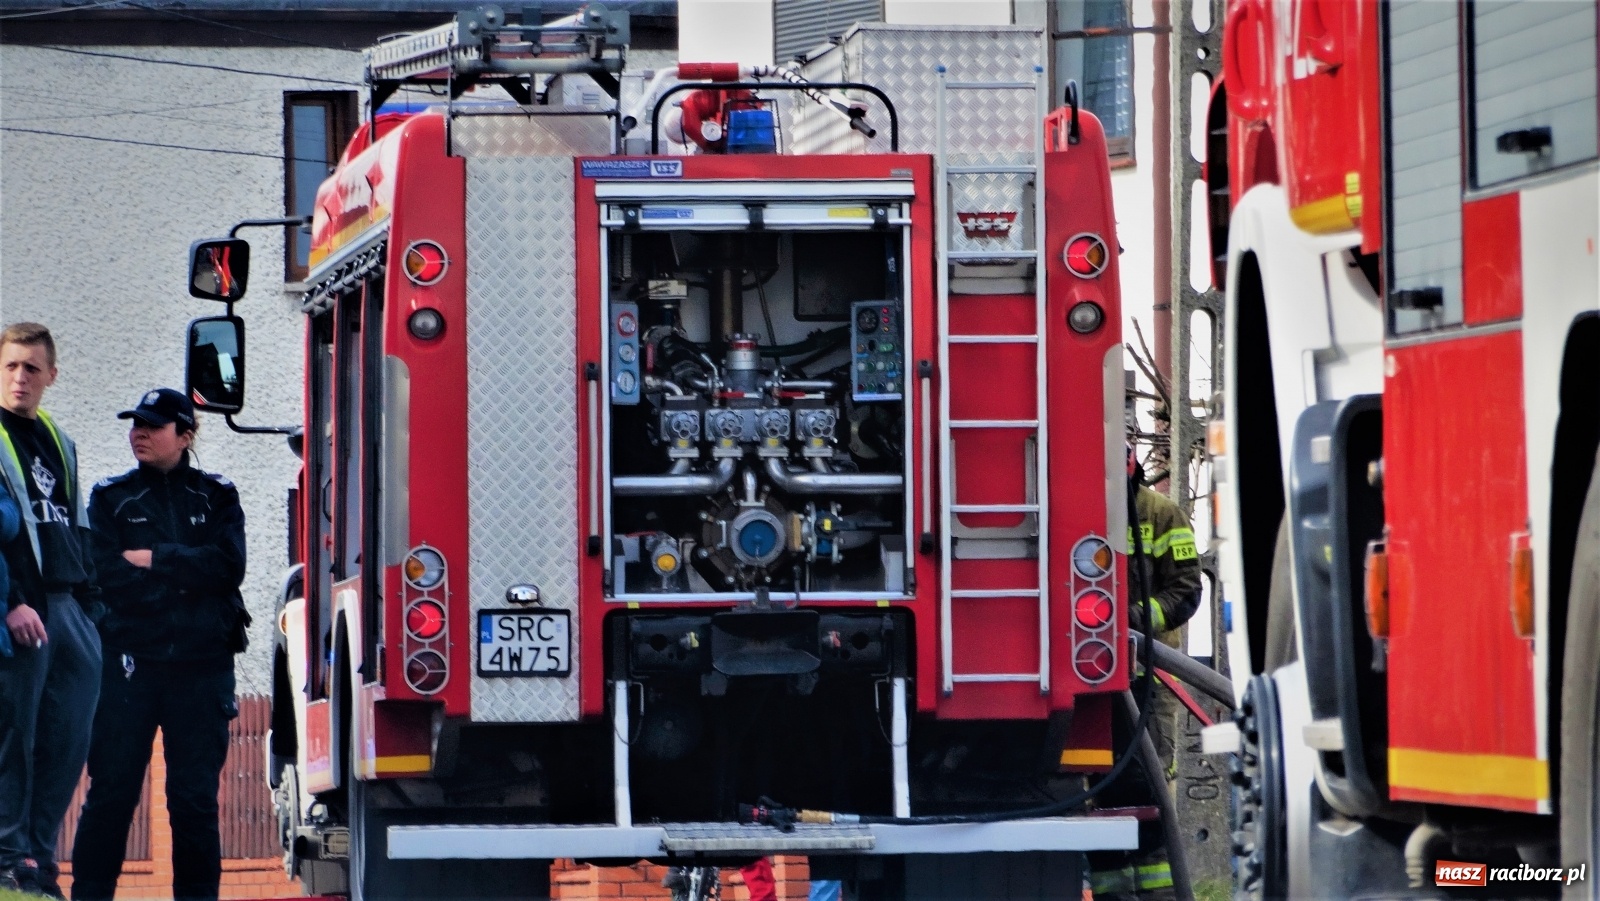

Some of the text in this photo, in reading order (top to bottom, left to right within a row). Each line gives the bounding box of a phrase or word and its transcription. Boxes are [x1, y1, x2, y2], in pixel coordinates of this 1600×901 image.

[1176, 547, 1193, 558] PSP
[498, 616, 555, 641] SRC
[488, 646, 560, 671] 4W75
